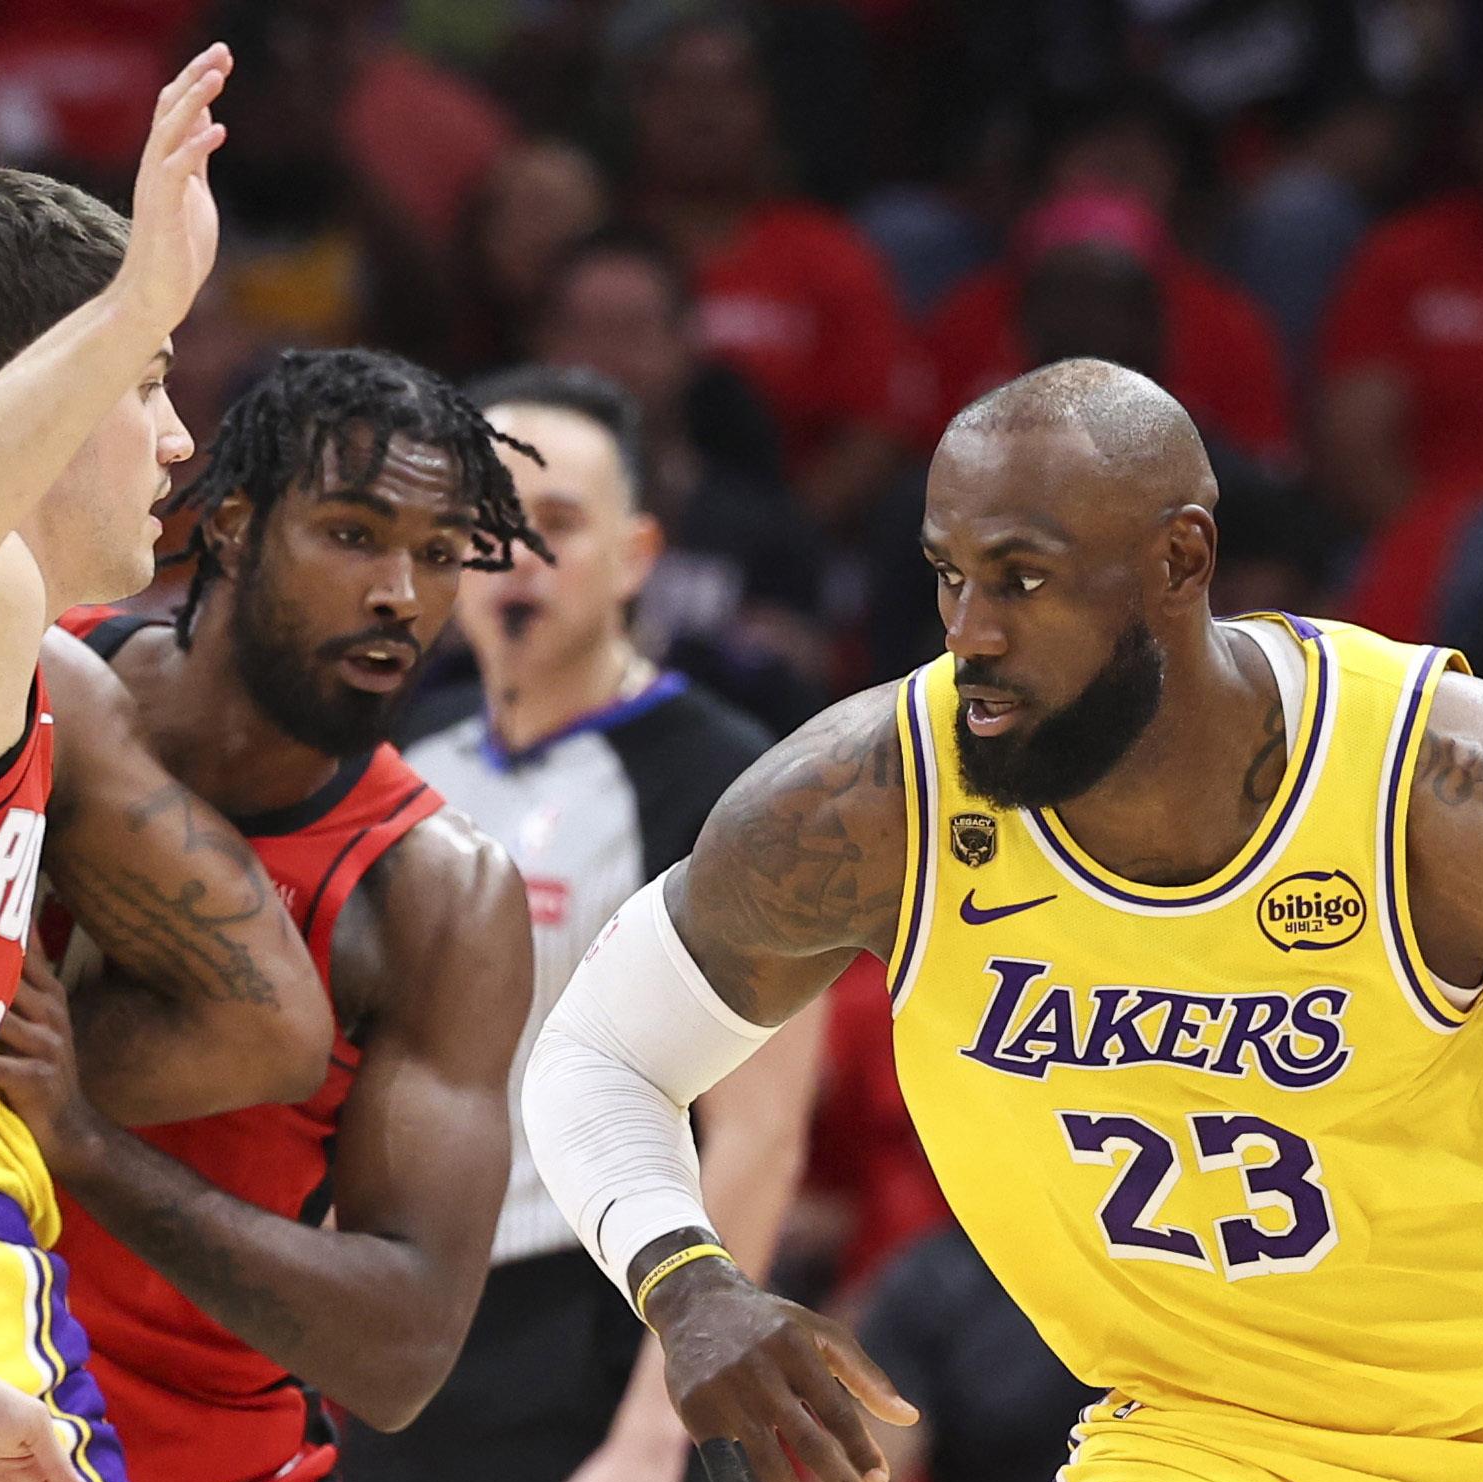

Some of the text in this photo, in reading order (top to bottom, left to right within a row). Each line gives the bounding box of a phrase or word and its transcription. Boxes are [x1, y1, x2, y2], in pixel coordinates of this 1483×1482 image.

[954, 817, 992, 827] LEGACY
[1268, 891, 1361, 927] bibigo
[1285, 919, 1324, 935] 비비고
[956, 955, 1355, 1092] LAKERS
[1052, 1109, 1340, 1283] 23
